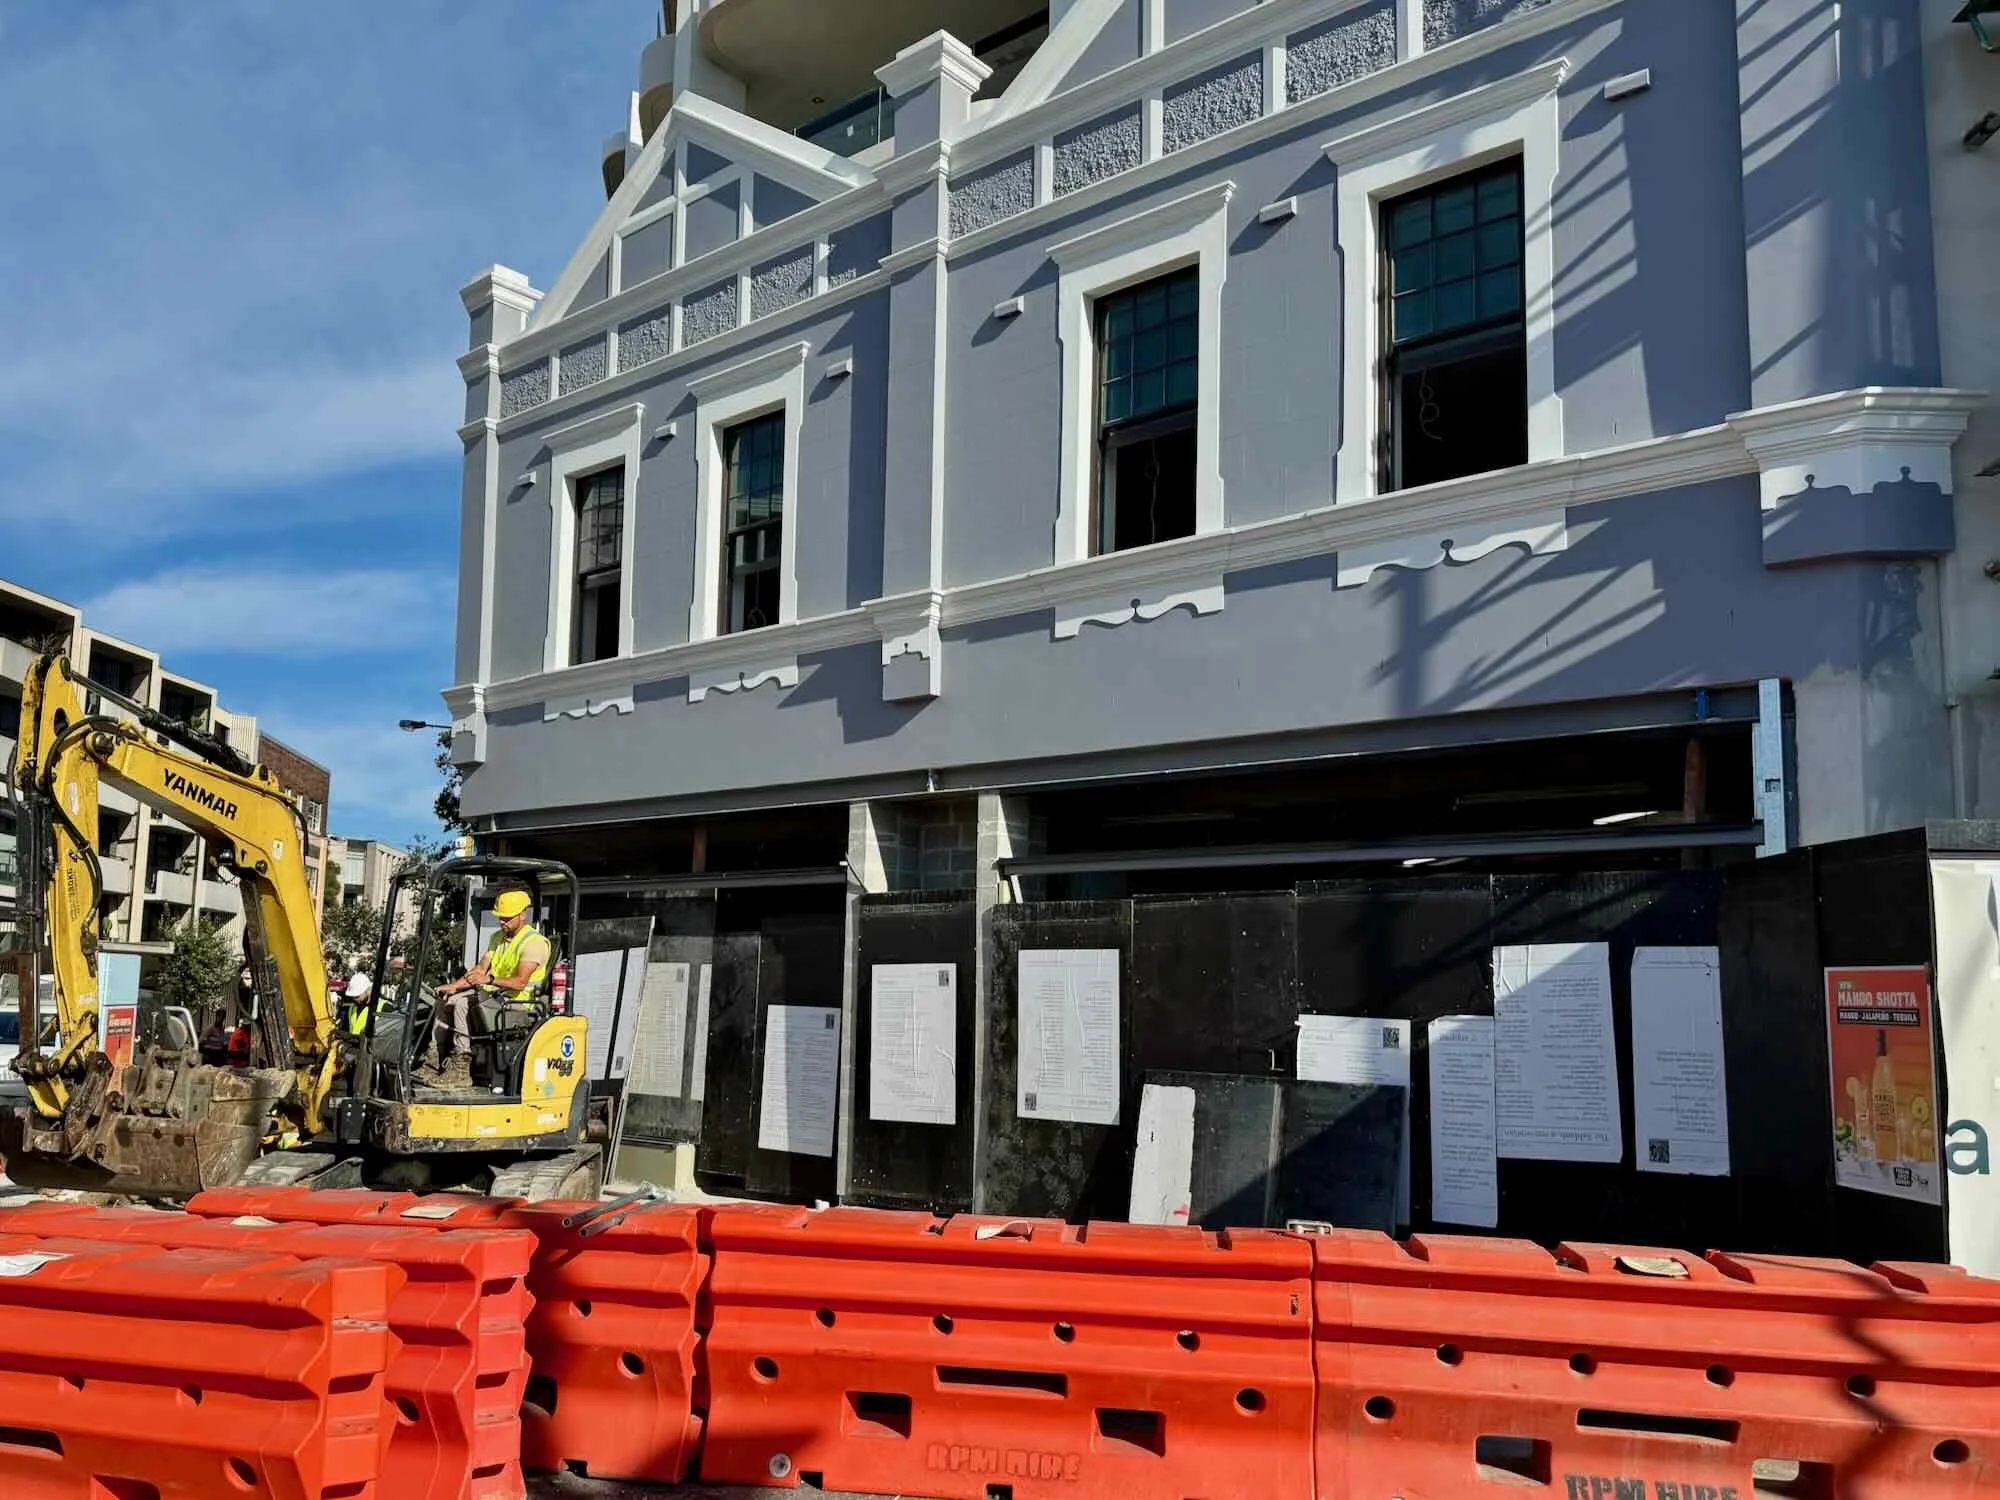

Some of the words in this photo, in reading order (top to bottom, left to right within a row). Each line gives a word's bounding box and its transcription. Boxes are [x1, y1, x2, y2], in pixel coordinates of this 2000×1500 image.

[164, 768, 239, 821] YANMAR
[1876, 991, 1917, 1009] SHOTTA
[927, 1443, 999, 1473] RPM
[1565, 1473, 1646, 1500] RPM
